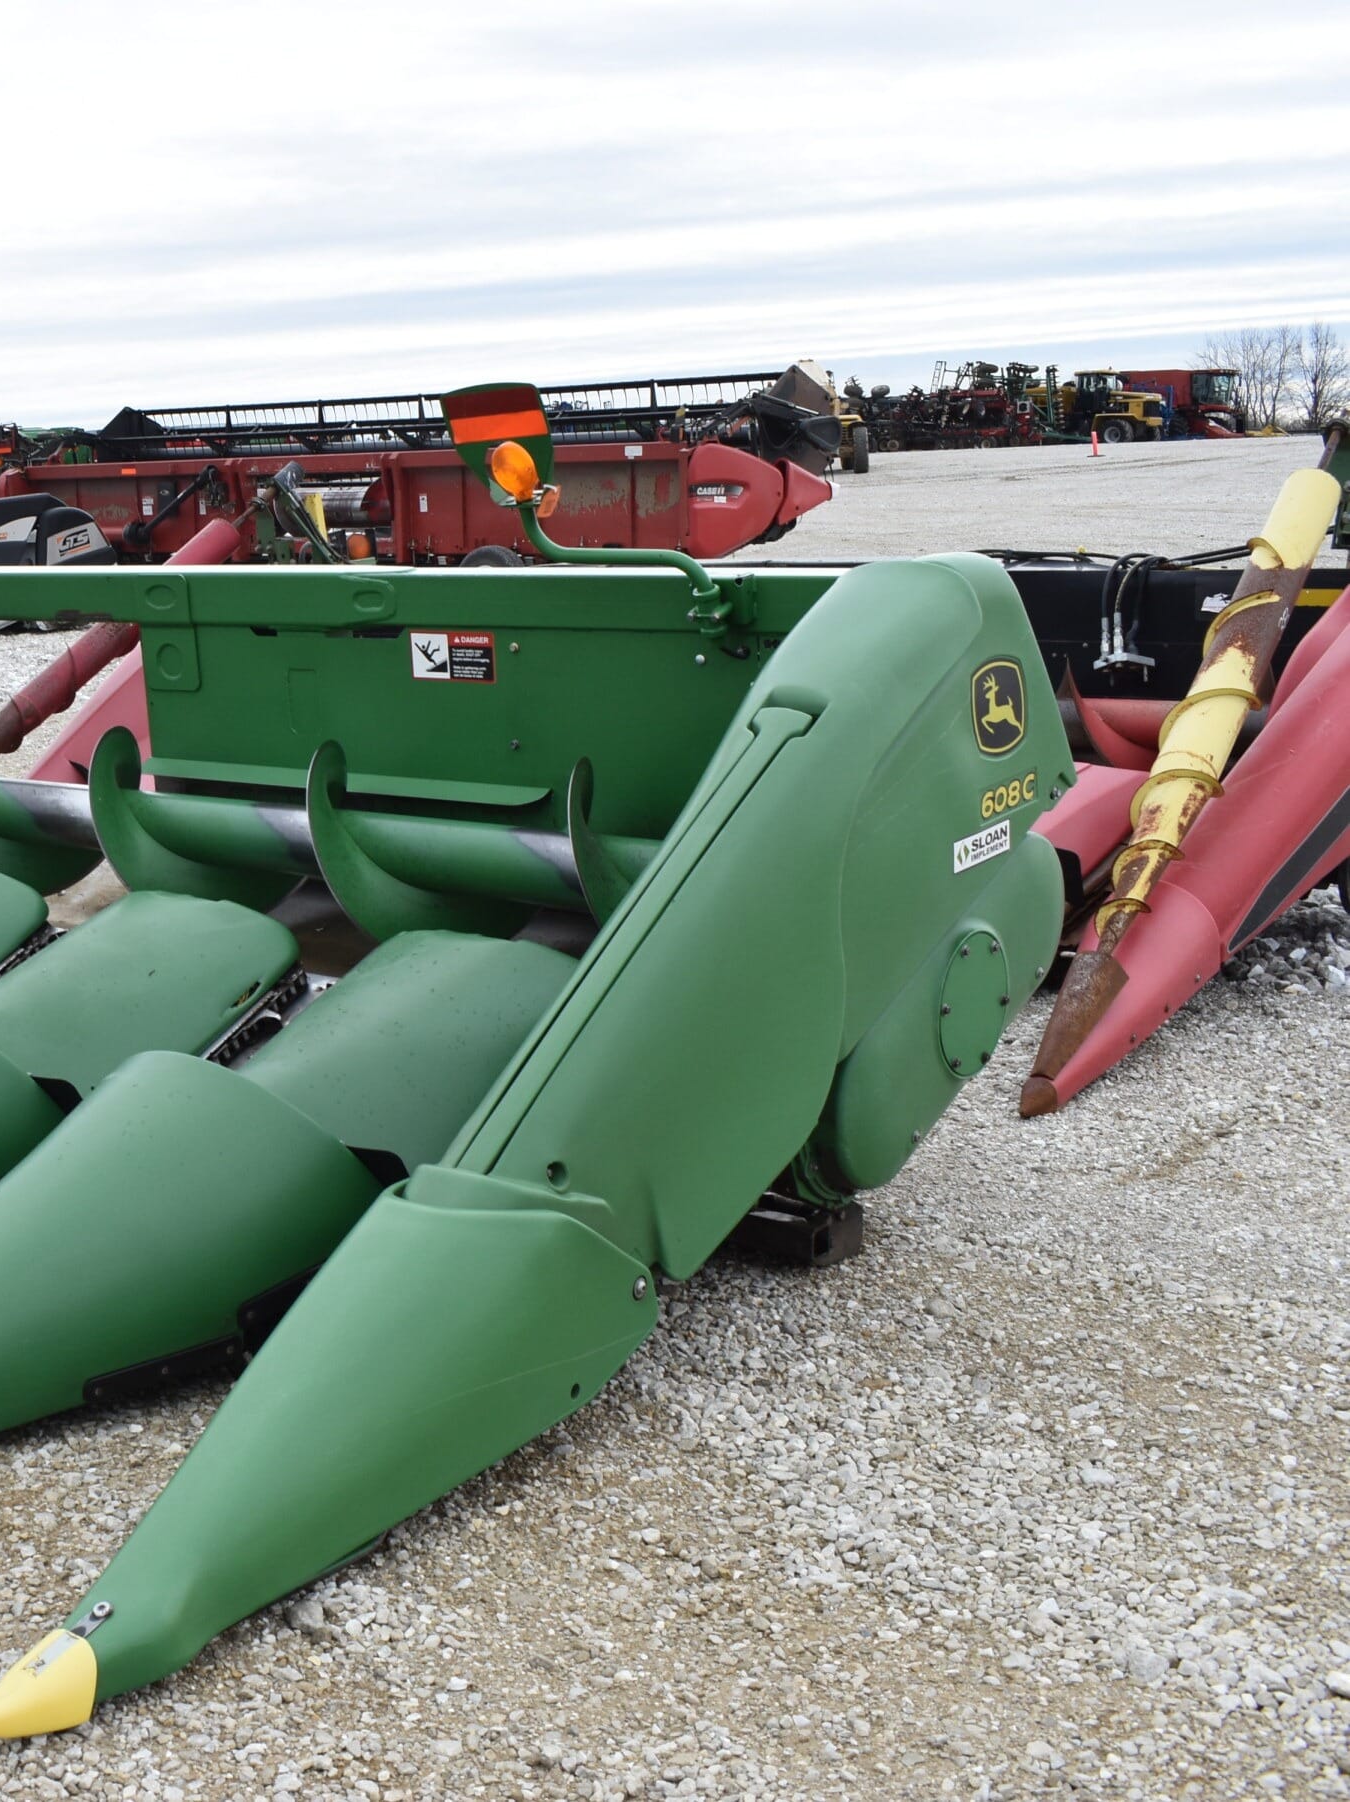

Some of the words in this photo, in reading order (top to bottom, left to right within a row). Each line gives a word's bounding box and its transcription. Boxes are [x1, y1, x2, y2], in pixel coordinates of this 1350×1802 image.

[697, 486, 717, 496] CASE
[460, 635, 490, 645] DANGER
[971, 825, 1009, 853] SLOAN
[970, 839, 1008, 862] IMPLEMENT
